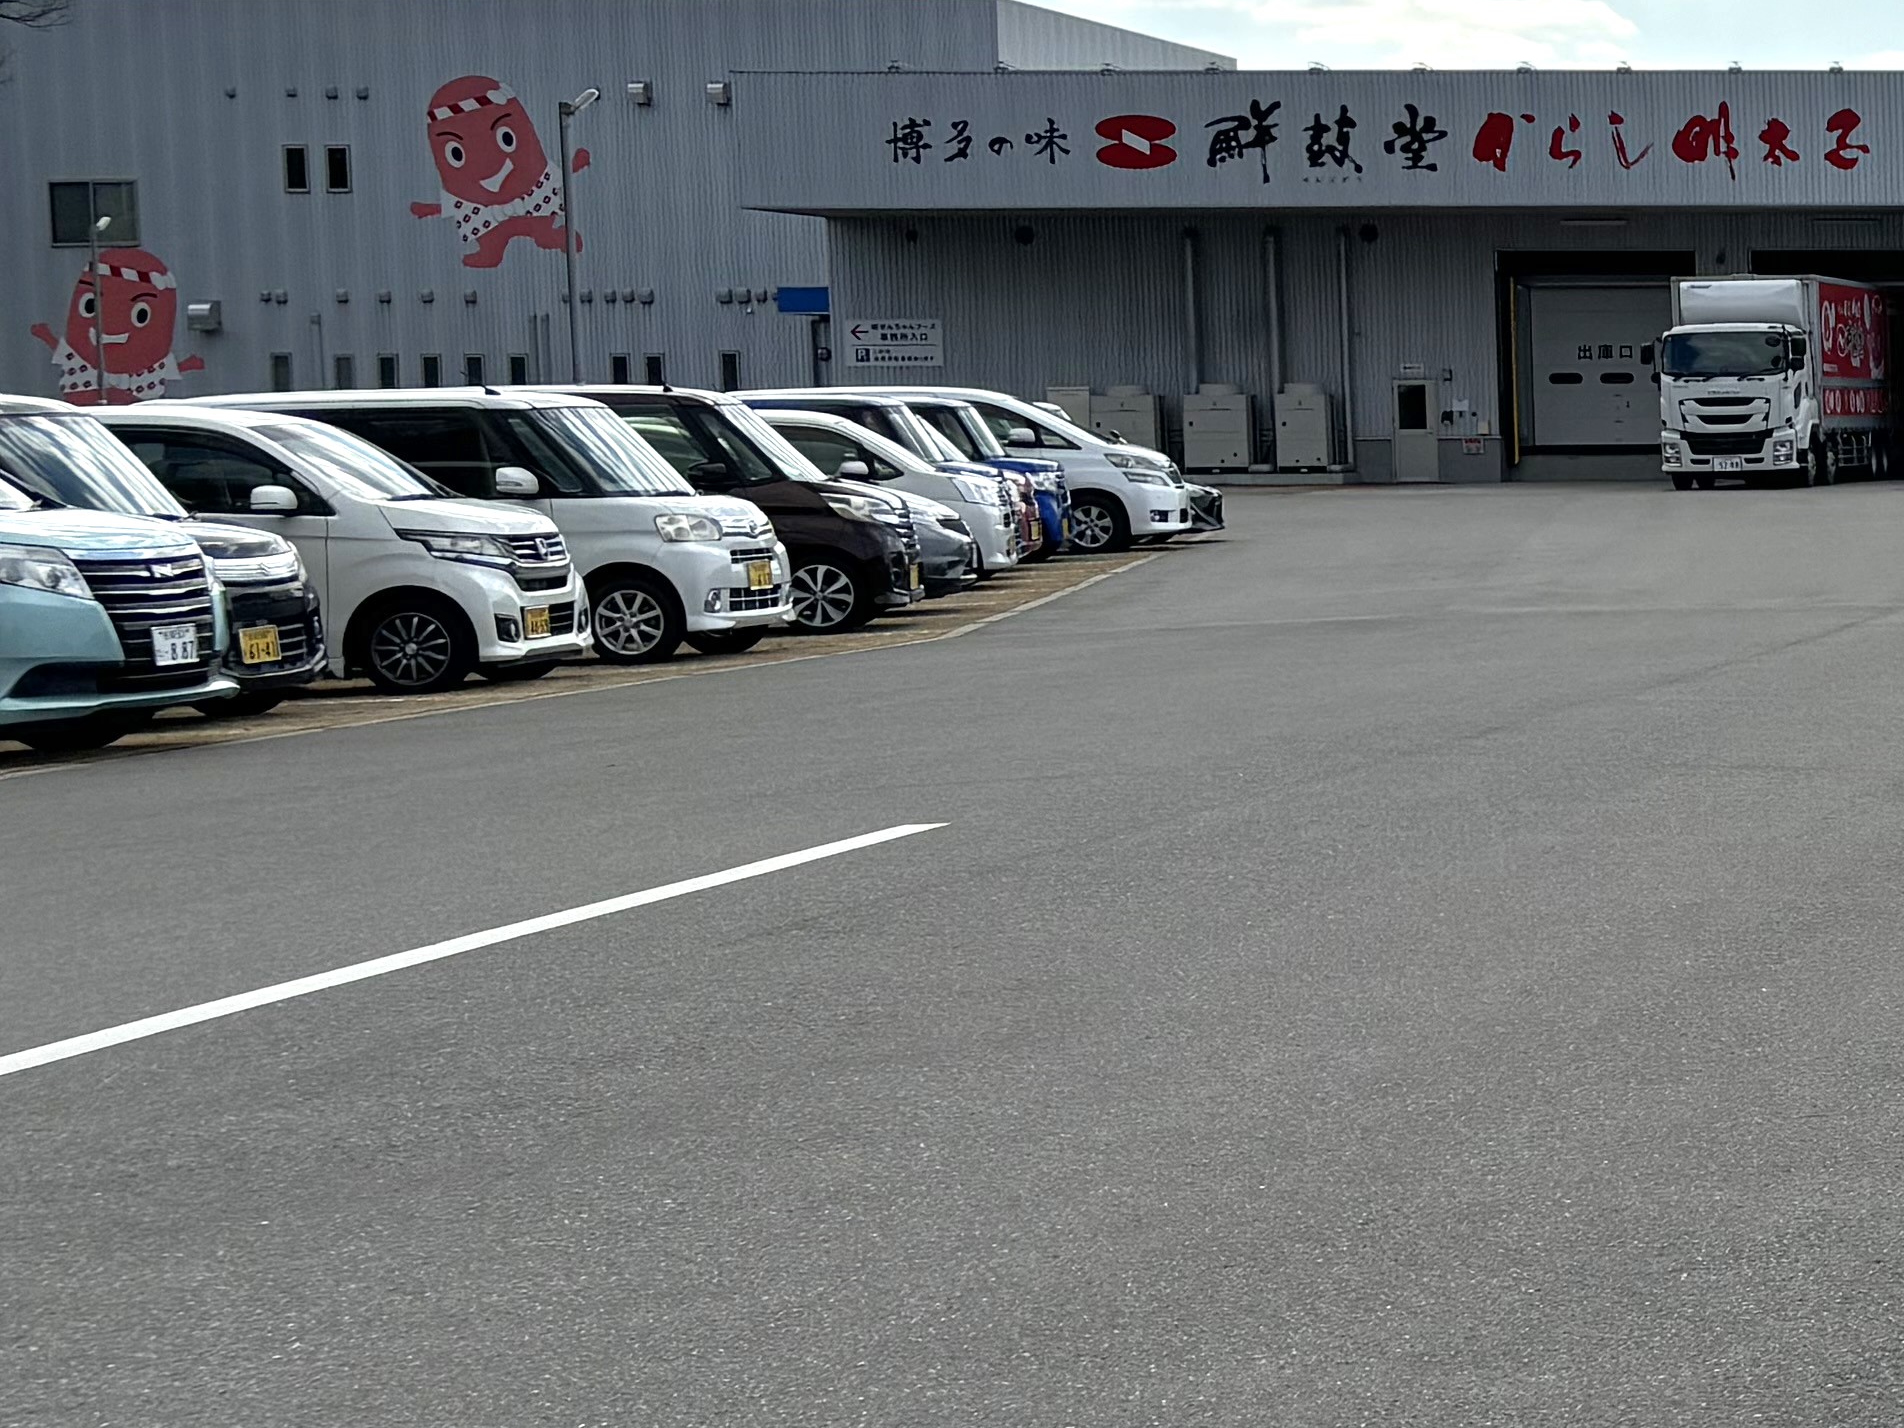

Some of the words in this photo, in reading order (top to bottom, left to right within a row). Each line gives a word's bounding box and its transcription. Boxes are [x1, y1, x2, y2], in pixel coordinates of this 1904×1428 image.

[886, 117, 1071, 165] 博多の味
[1473, 101, 1869, 181] からし明太子
[1577, 344, 1633, 360] 出庫口
